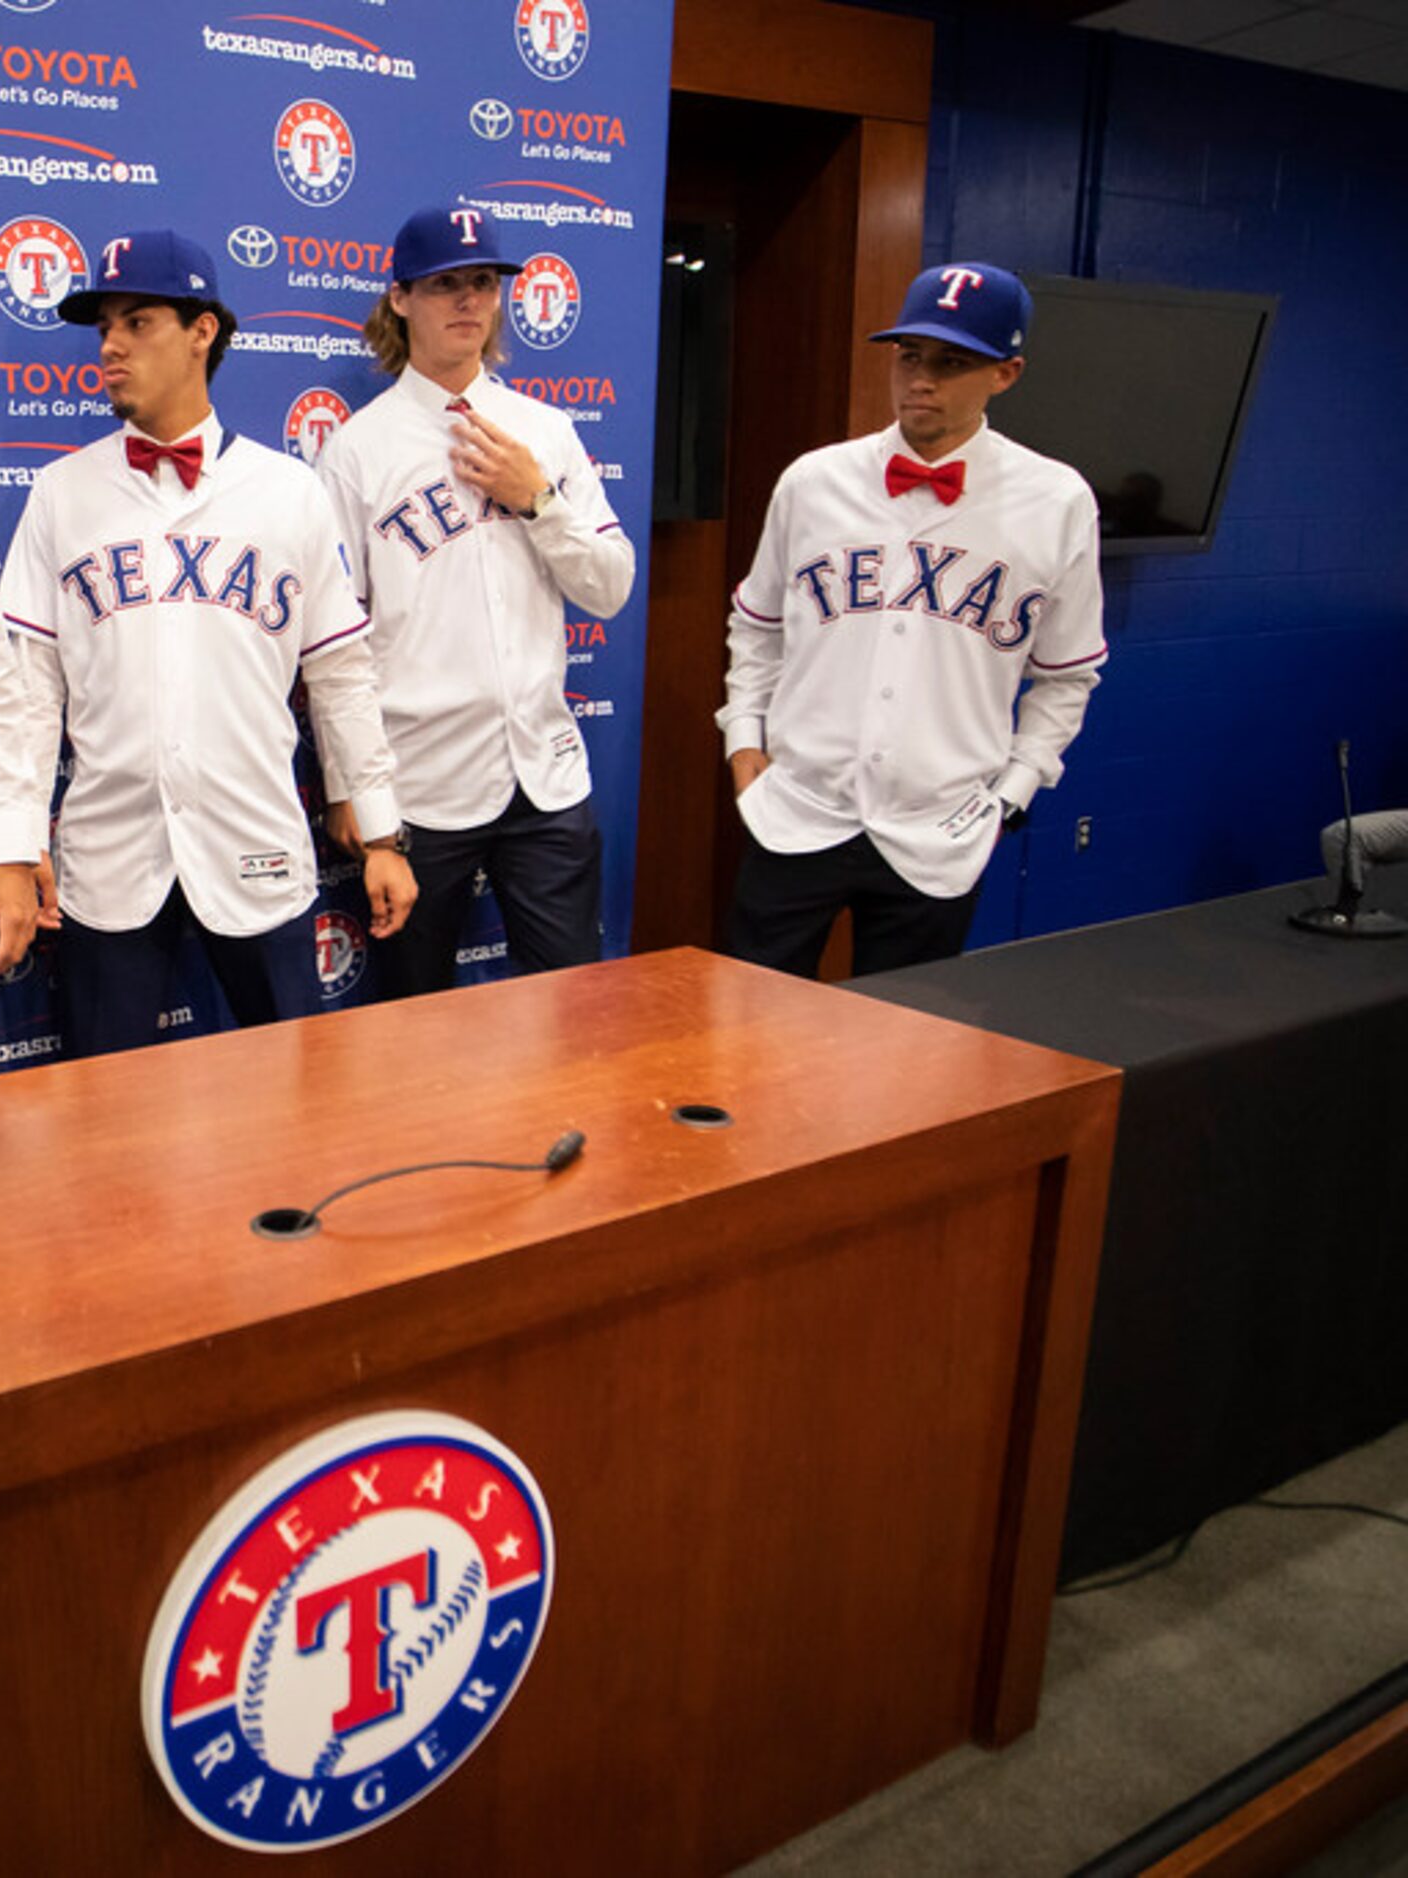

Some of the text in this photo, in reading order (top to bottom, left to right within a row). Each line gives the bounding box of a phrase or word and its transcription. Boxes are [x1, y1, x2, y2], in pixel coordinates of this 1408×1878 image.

[202, 24, 417, 80] texasrangers.com
[33, 87, 58, 106] Go
[62, 89, 120, 111] Places
[516, 108, 627, 148] TOYOTA
[450, 209, 483, 247] T
[102, 236, 133, 281] T
[936, 267, 984, 311] T
[8, 398, 114, 417] Let's Go Plac
[509, 376, 617, 405] TOYOTA
[57, 532, 302, 636] TEXAS
[795, 540, 1049, 653] TEXAS
[217, 1458, 502, 1607] TEXAS
[295, 1546, 438, 1740] T
[193, 1617, 524, 1828] RANGERS
